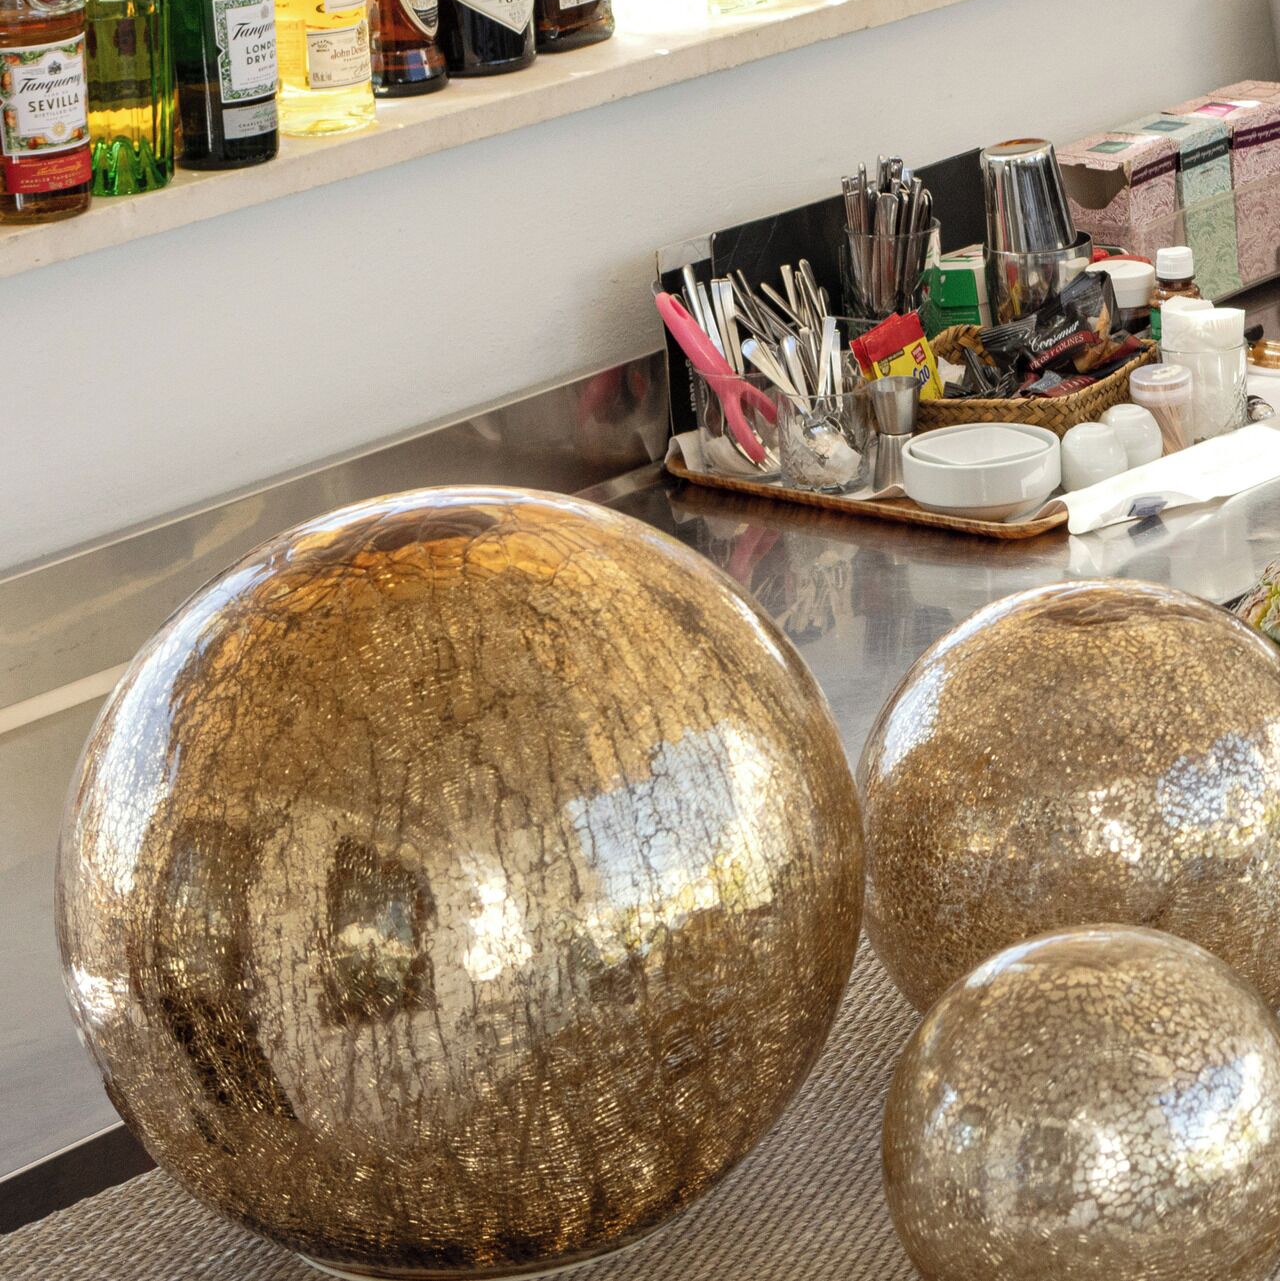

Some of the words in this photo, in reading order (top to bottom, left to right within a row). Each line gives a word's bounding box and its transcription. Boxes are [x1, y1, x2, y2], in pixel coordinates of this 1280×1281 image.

[246, 56, 266, 66] DRY
[19, 73, 82, 94] Tanqueray
[28, 92, 79, 113] SEVILLA
